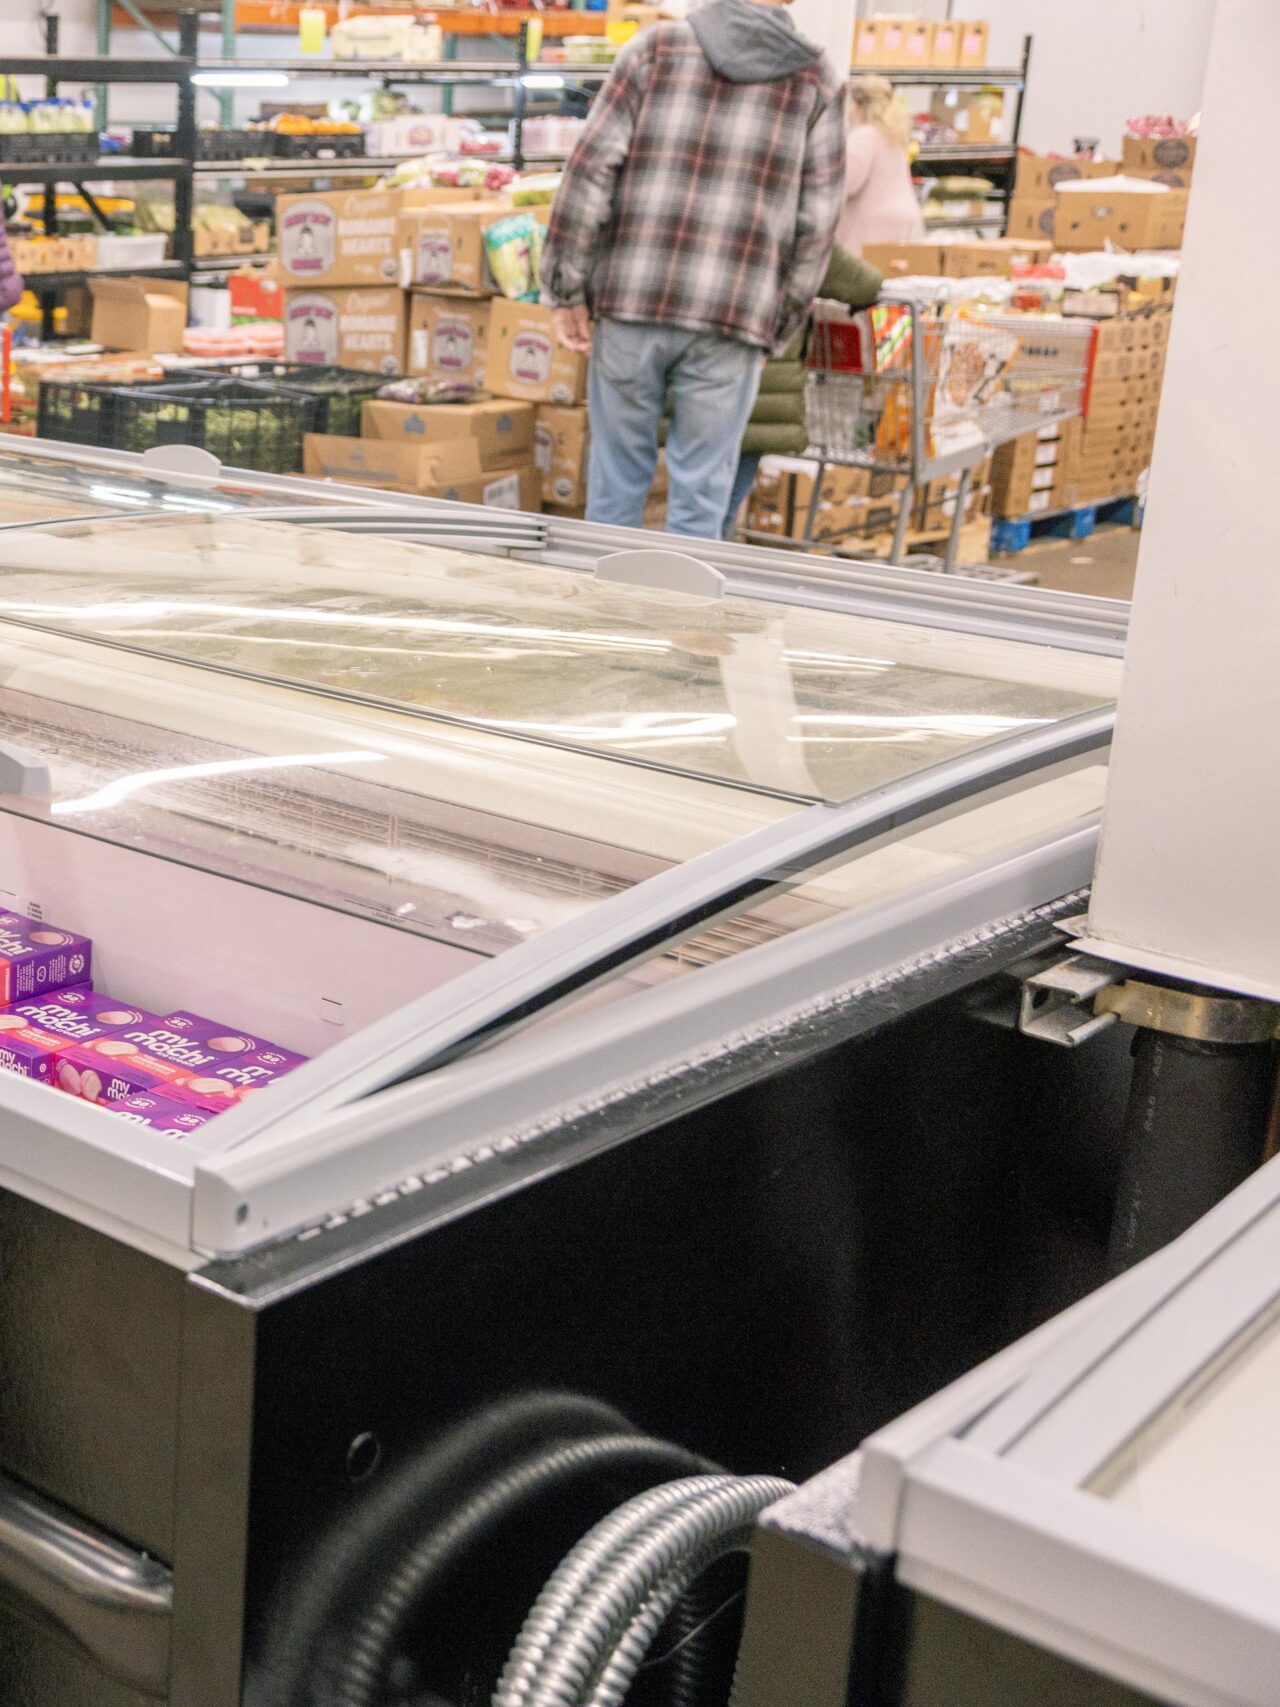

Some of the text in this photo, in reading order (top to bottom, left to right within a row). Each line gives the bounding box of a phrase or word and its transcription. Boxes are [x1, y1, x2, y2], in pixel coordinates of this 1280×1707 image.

[16, 1005, 101, 1036] mochi
[40, 1004, 89, 1021] my
[123, 1031, 215, 1065] mochi
[148, 1030, 200, 1048] my
[112, 1078, 130, 1097] my
